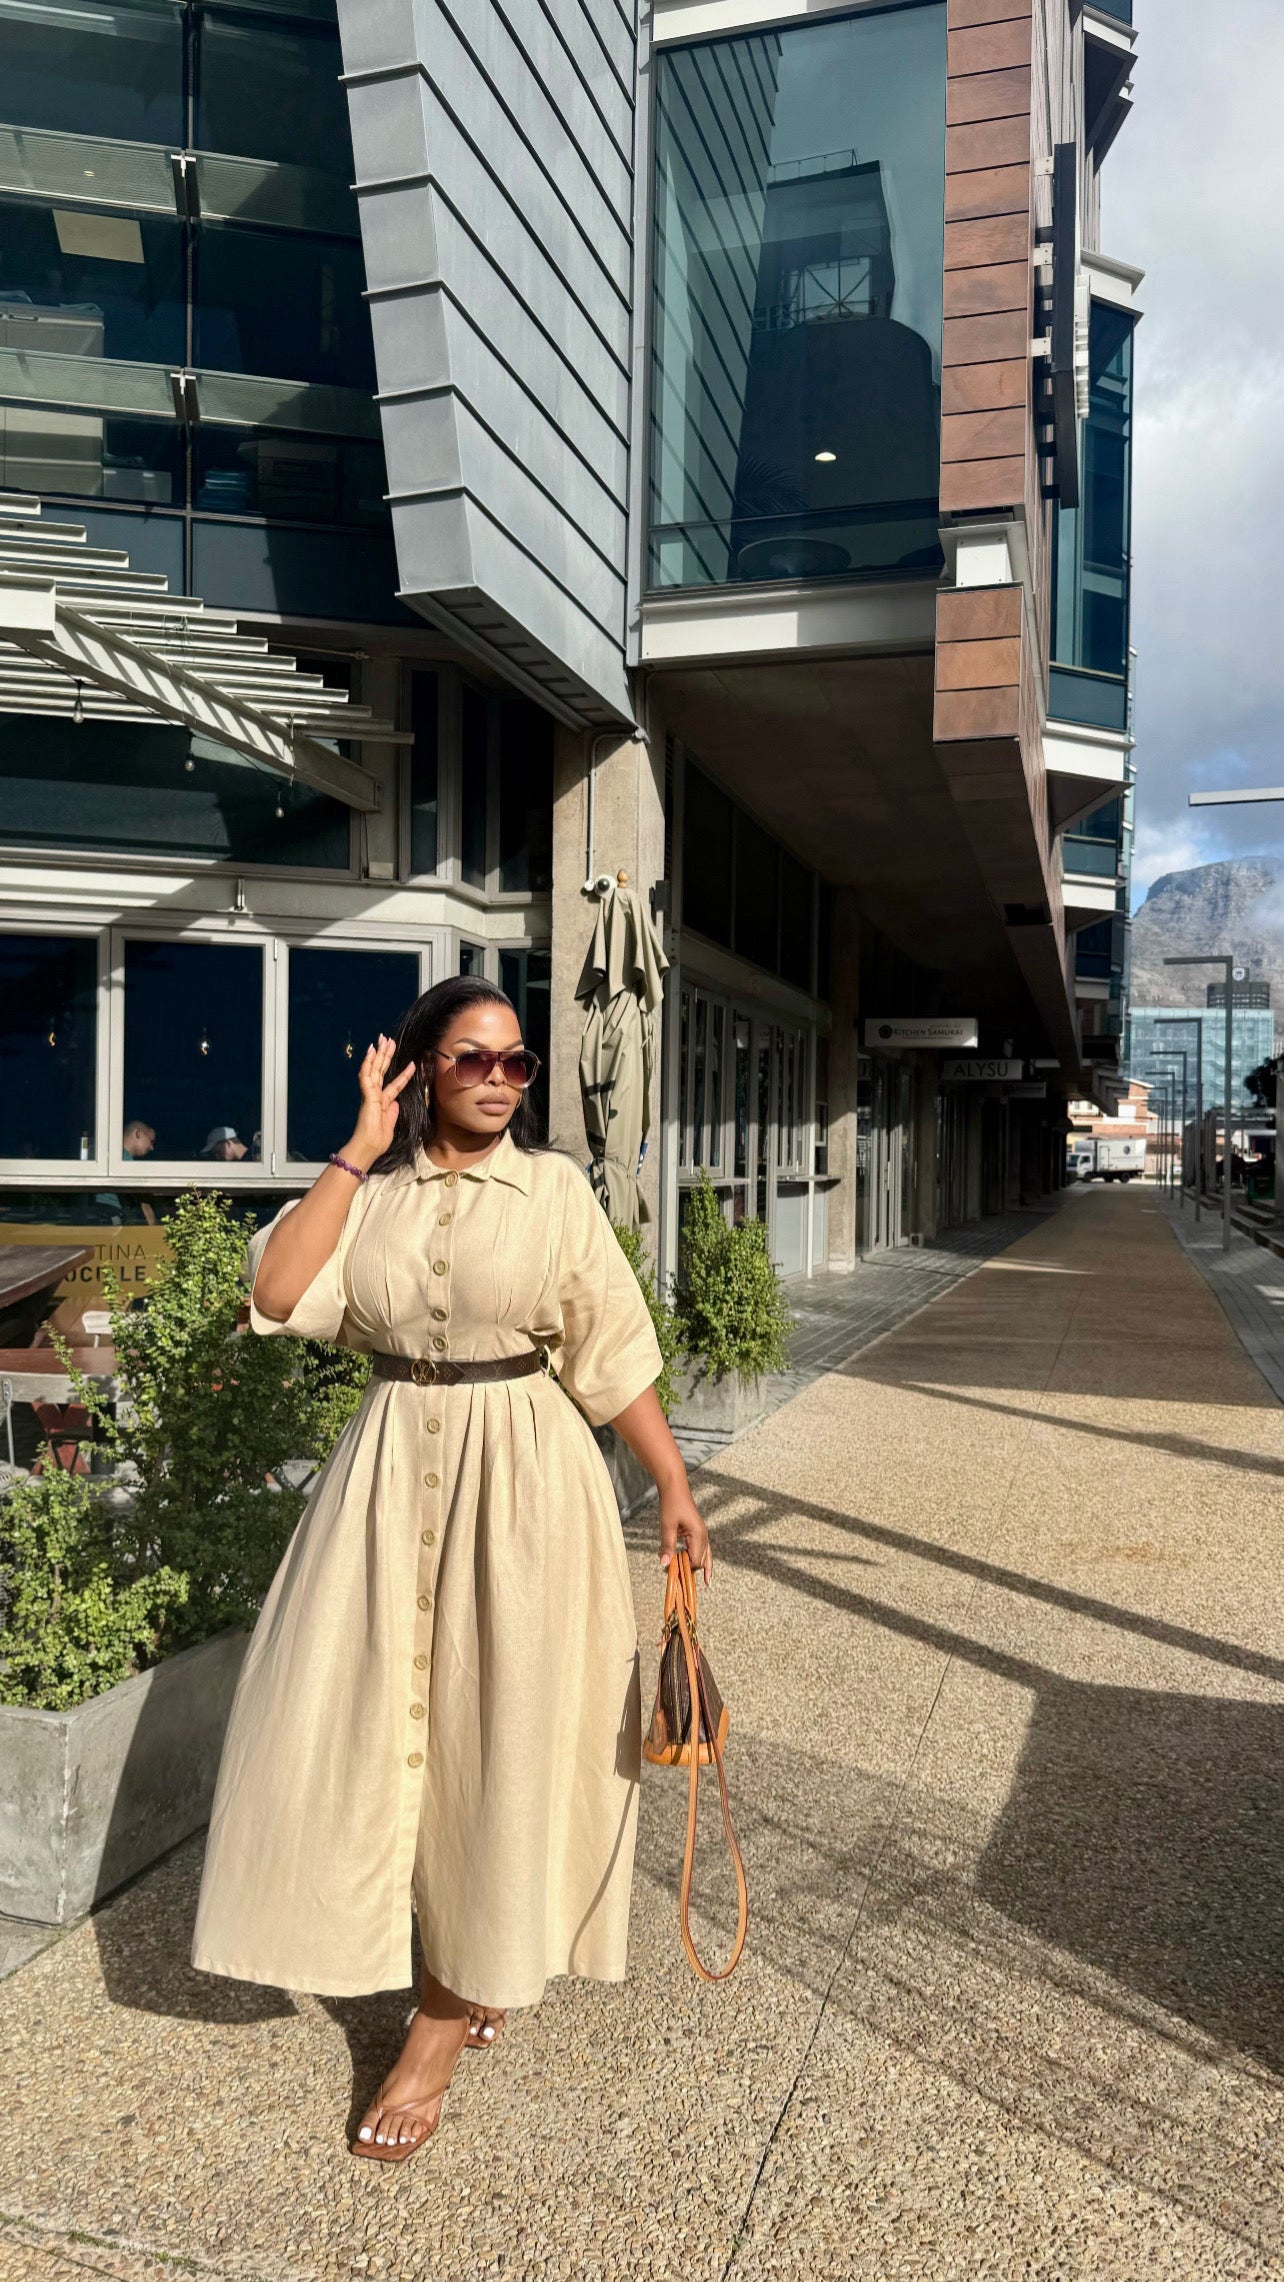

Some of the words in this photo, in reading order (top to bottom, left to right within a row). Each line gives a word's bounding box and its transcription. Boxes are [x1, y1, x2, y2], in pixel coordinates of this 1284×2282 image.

[893, 1027, 926, 1036] KITCHEN
[928, 1026, 963, 1036] SAMURAI
[953, 1062, 1009, 1077] ALYSU
[94, 1243, 146, 1261] TINA
